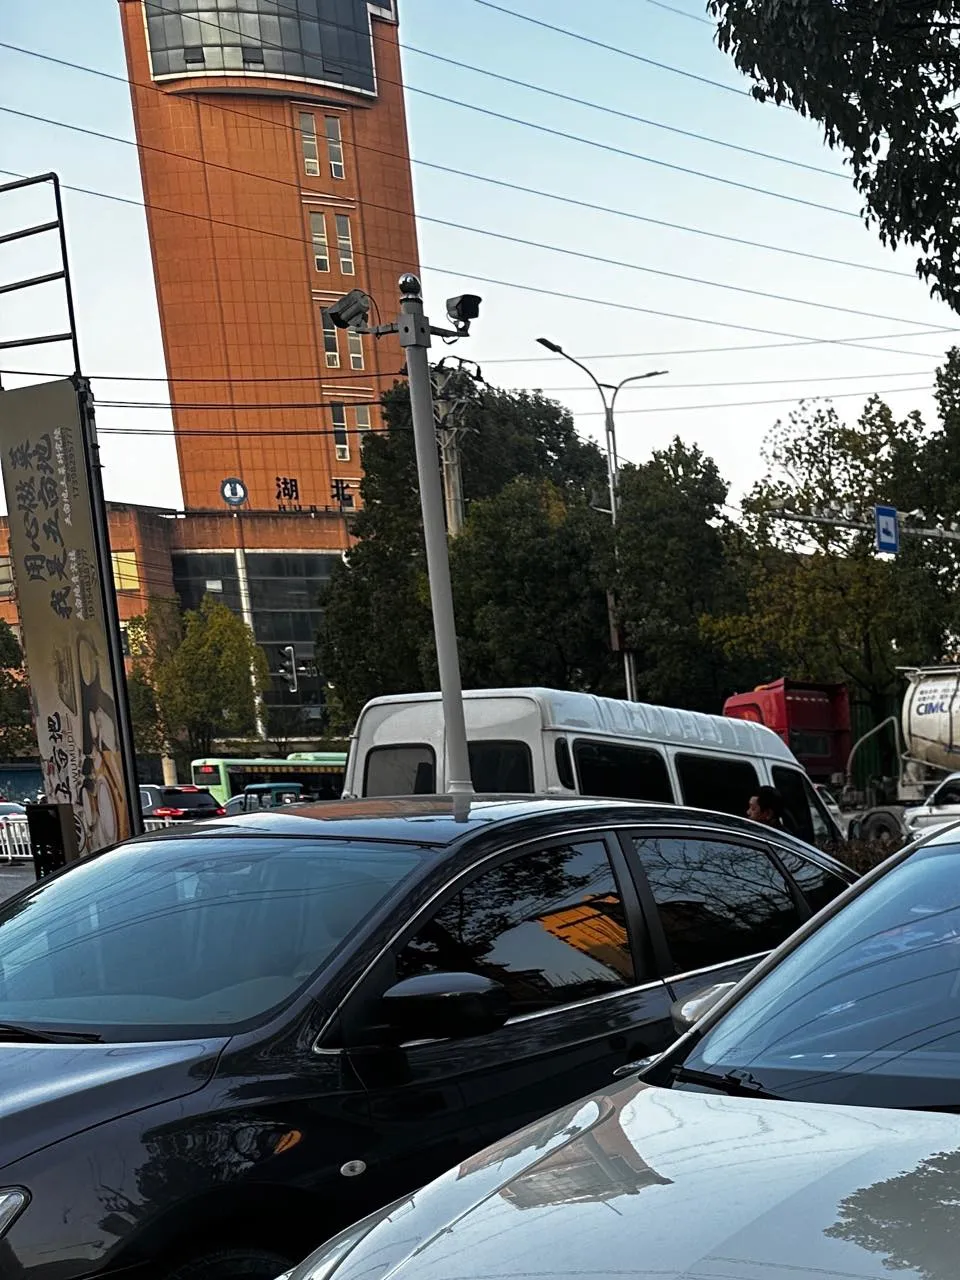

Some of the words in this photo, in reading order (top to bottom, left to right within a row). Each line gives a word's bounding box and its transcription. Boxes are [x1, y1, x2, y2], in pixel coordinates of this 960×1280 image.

[9, 439, 47, 583] 用心做菜
[33, 434, 73, 620] 我是五亩地
[275, 476, 353, 501] 湖北
[46, 711, 73, 803] 五亩地
[66, 730, 80, 784] WUMUDI
